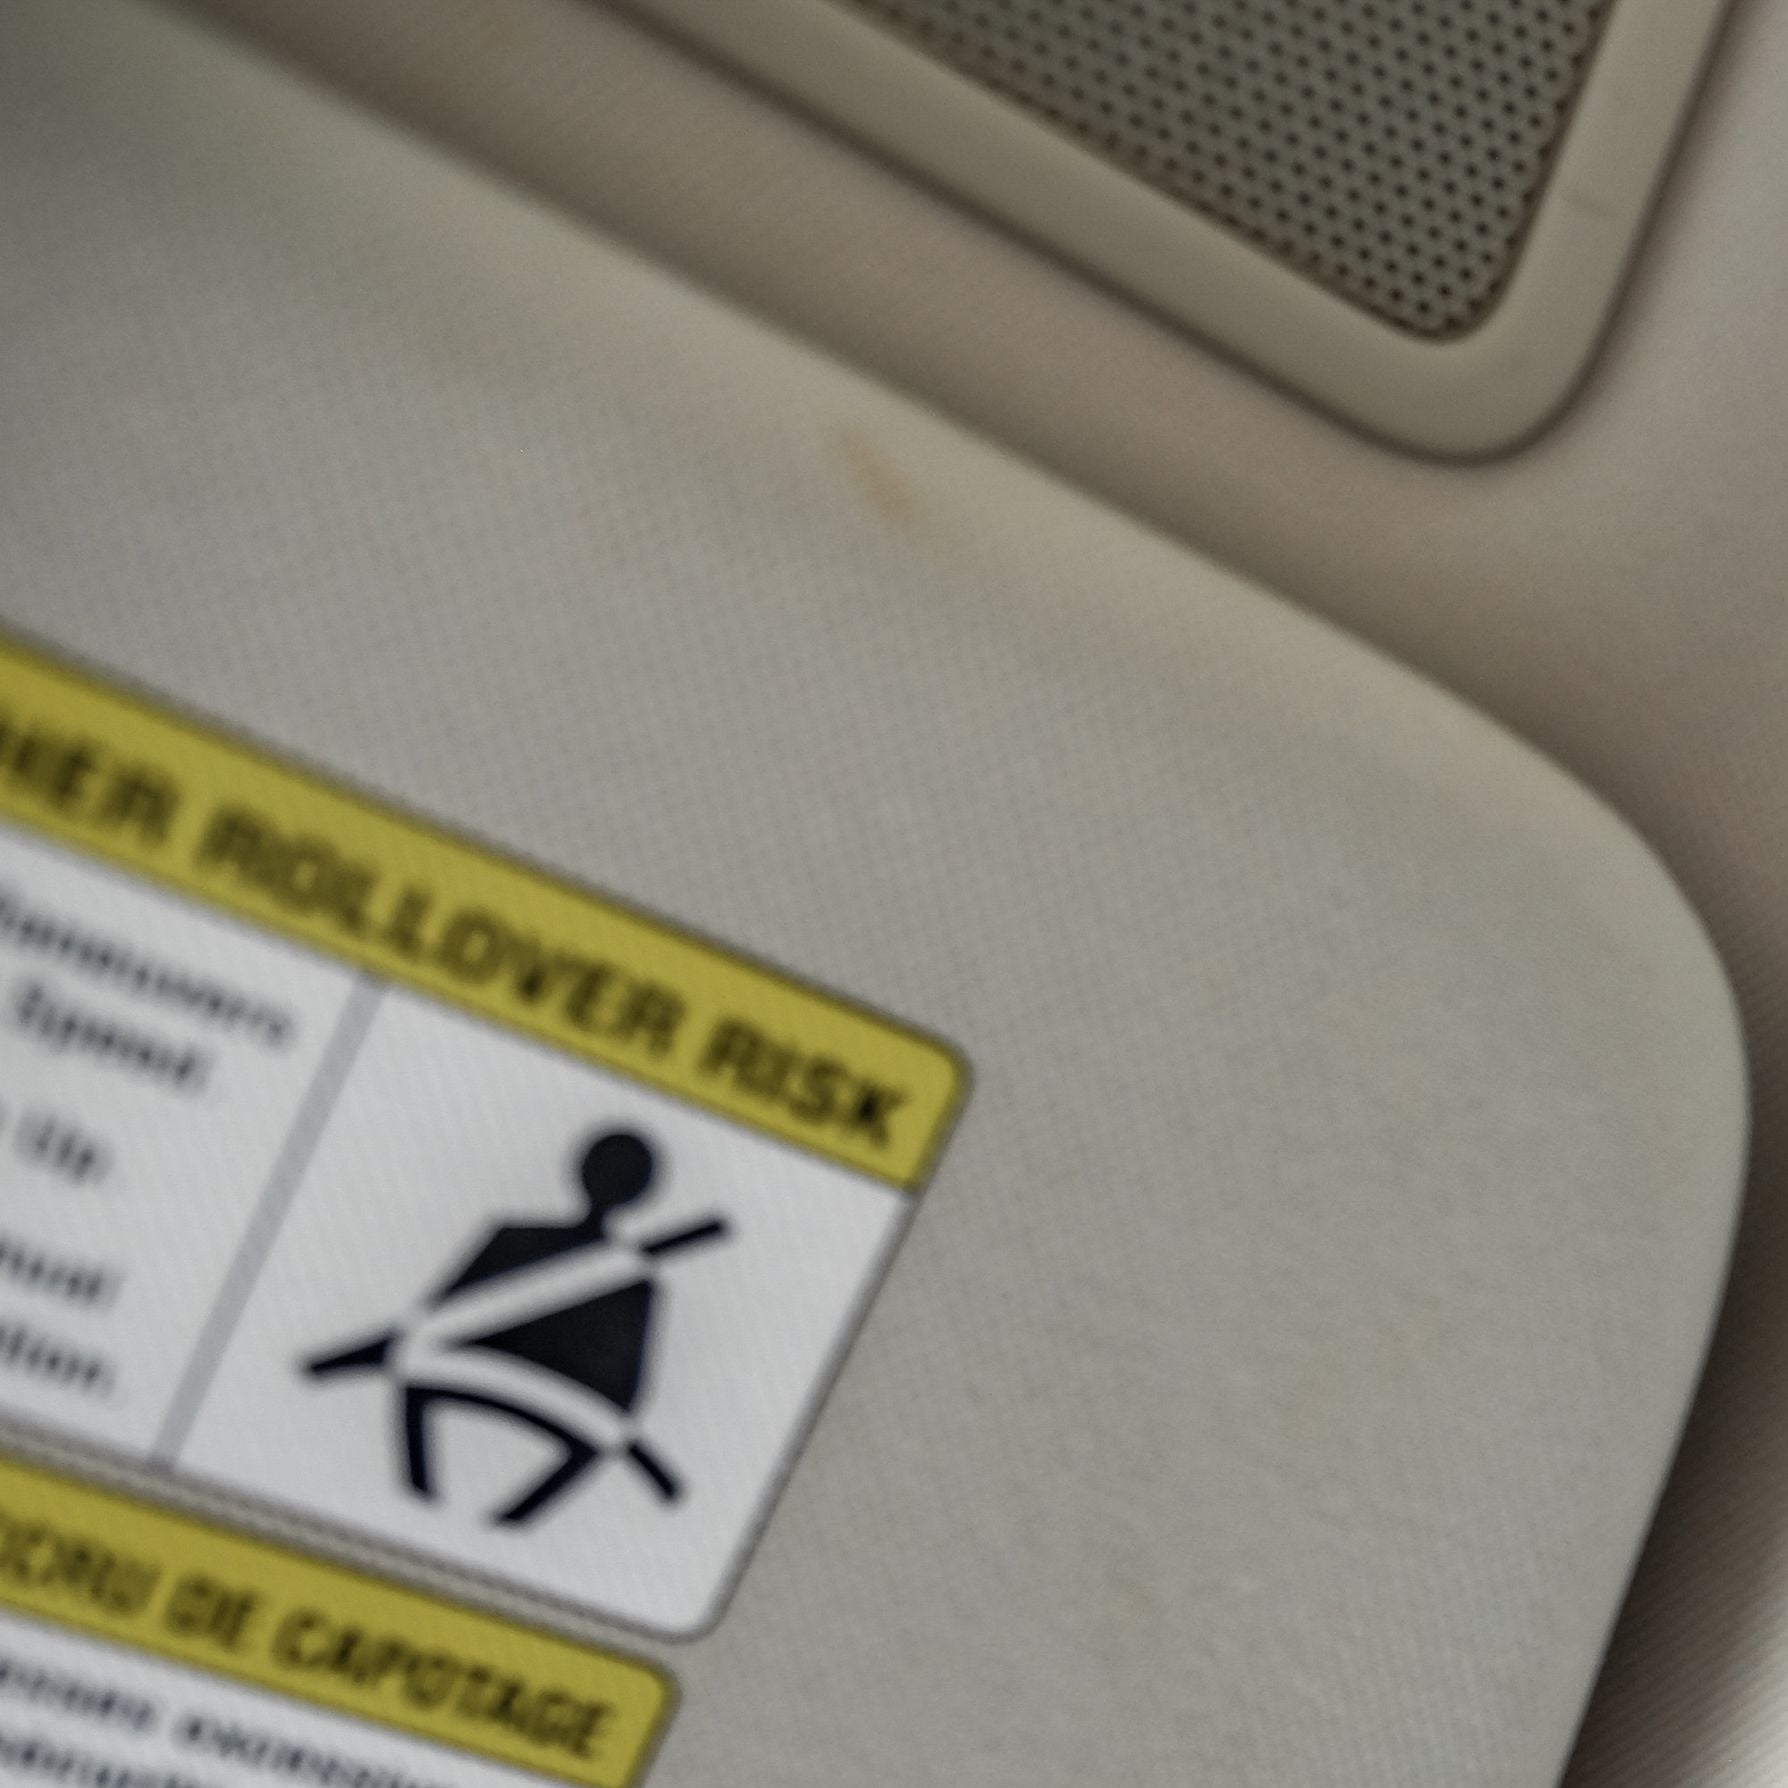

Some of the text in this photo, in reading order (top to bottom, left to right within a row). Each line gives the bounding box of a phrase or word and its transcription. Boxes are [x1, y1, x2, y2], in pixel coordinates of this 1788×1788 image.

[194, 802, 690, 1060] ROLLOVER
[699, 1014, 916, 1152] RISK
[270, 1606, 620, 1762] CAPOTAGE
